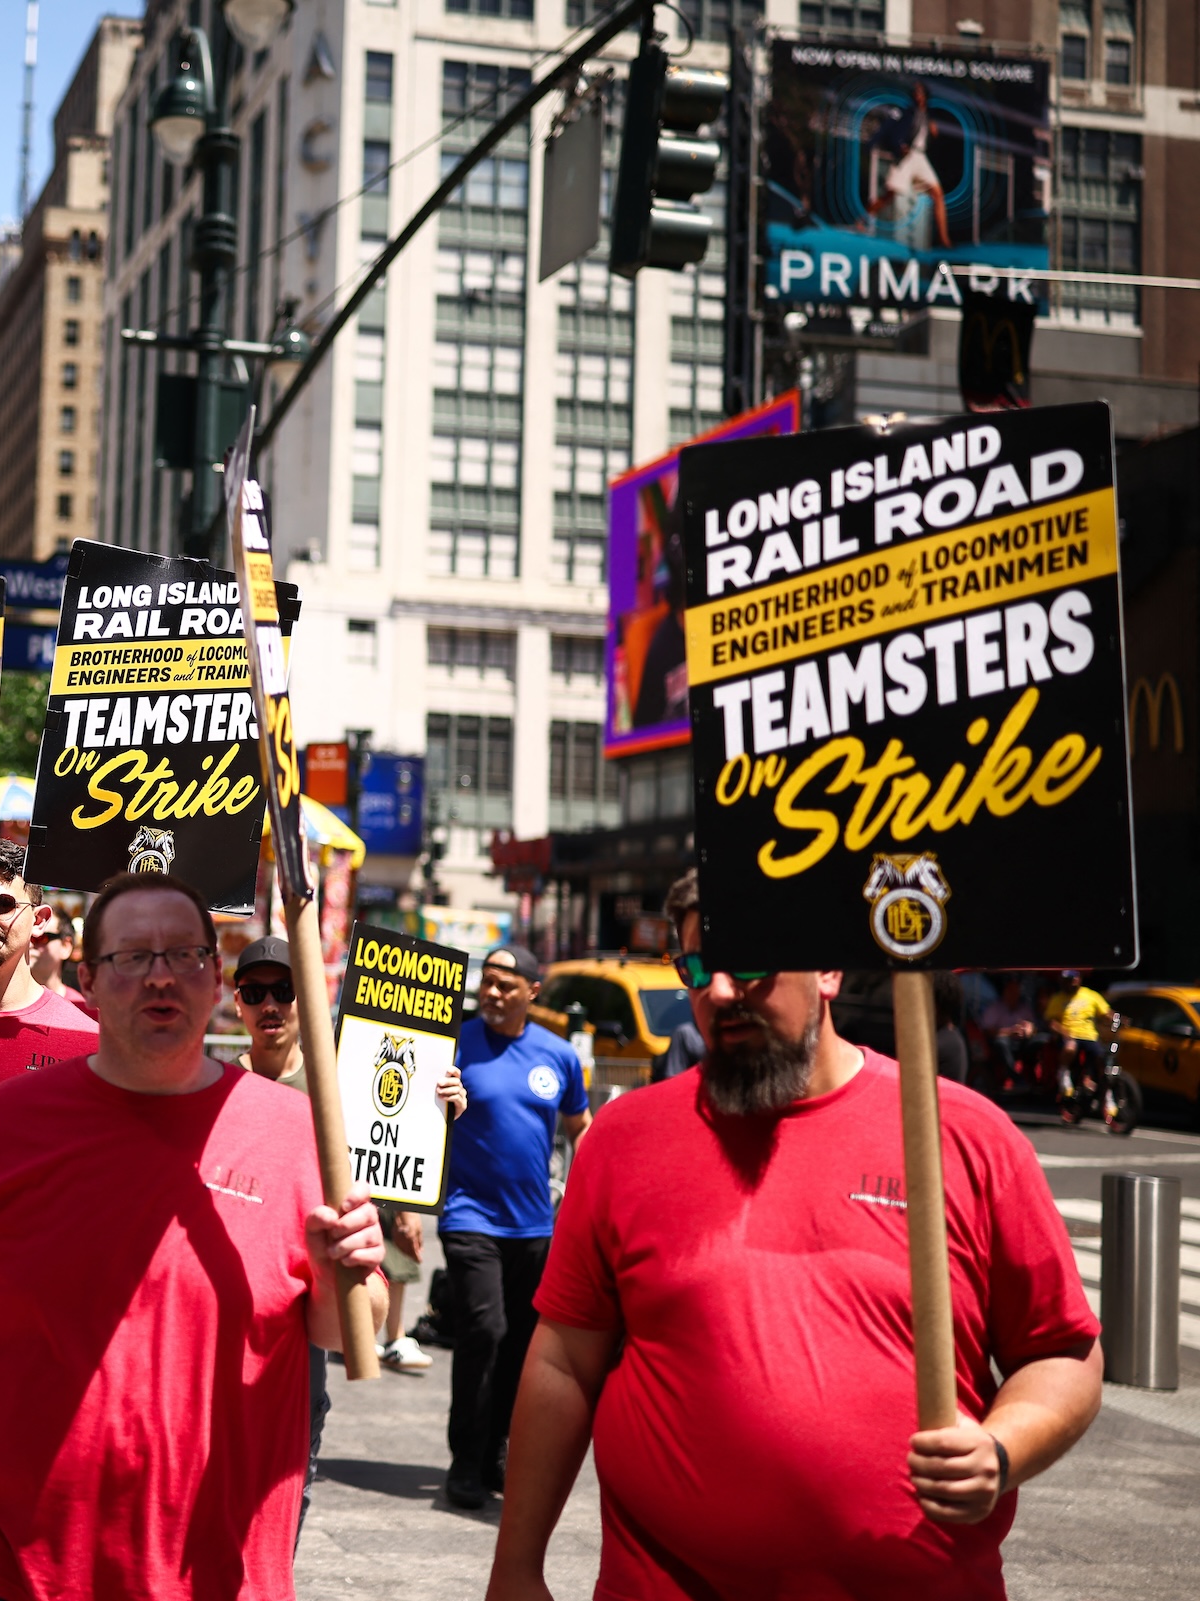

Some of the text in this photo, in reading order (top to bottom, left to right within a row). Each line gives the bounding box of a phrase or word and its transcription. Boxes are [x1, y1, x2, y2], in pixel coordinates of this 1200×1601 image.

[791, 47, 832, 66] NOW
[835, 50, 882, 70] OPEN
[904, 55, 968, 78] HERALD
[969, 60, 1035, 83] SQUARE
[780, 249, 1036, 305] PRIMARK
[705, 425, 1001, 547] LONG ISLAND
[706, 449, 1085, 596] RAIL ROAD
[5, 570, 64, 599] Wes
[78, 585, 150, 610] LONG
[158, 579, 241, 606] ISLAND
[711, 508, 1089, 635] BROTHERHOOD of LOCOMOTIVE
[73, 608, 247, 641] RAIL ROA
[712, 598, 875, 667] ENGINEERS
[924, 540, 1089, 606] TRAINMEN
[67, 666, 171, 687] ENGINEERS
[173, 667, 194, 682] and
[71, 647, 183, 666] BROTHERHOOD
[186, 649, 198, 666] of
[713, 590, 1095, 760] TEAMSTERS
[54, 744, 100, 778] On
[71, 743, 260, 829] Strike
[715, 686, 1102, 879] On Strike
[354, 937, 464, 992] LOCOMOTIVE
[355, 974, 453, 1026] ENGINEERS
[370, 1120, 399, 1148] ON
[347, 1145, 425, 1192] TRIKE
